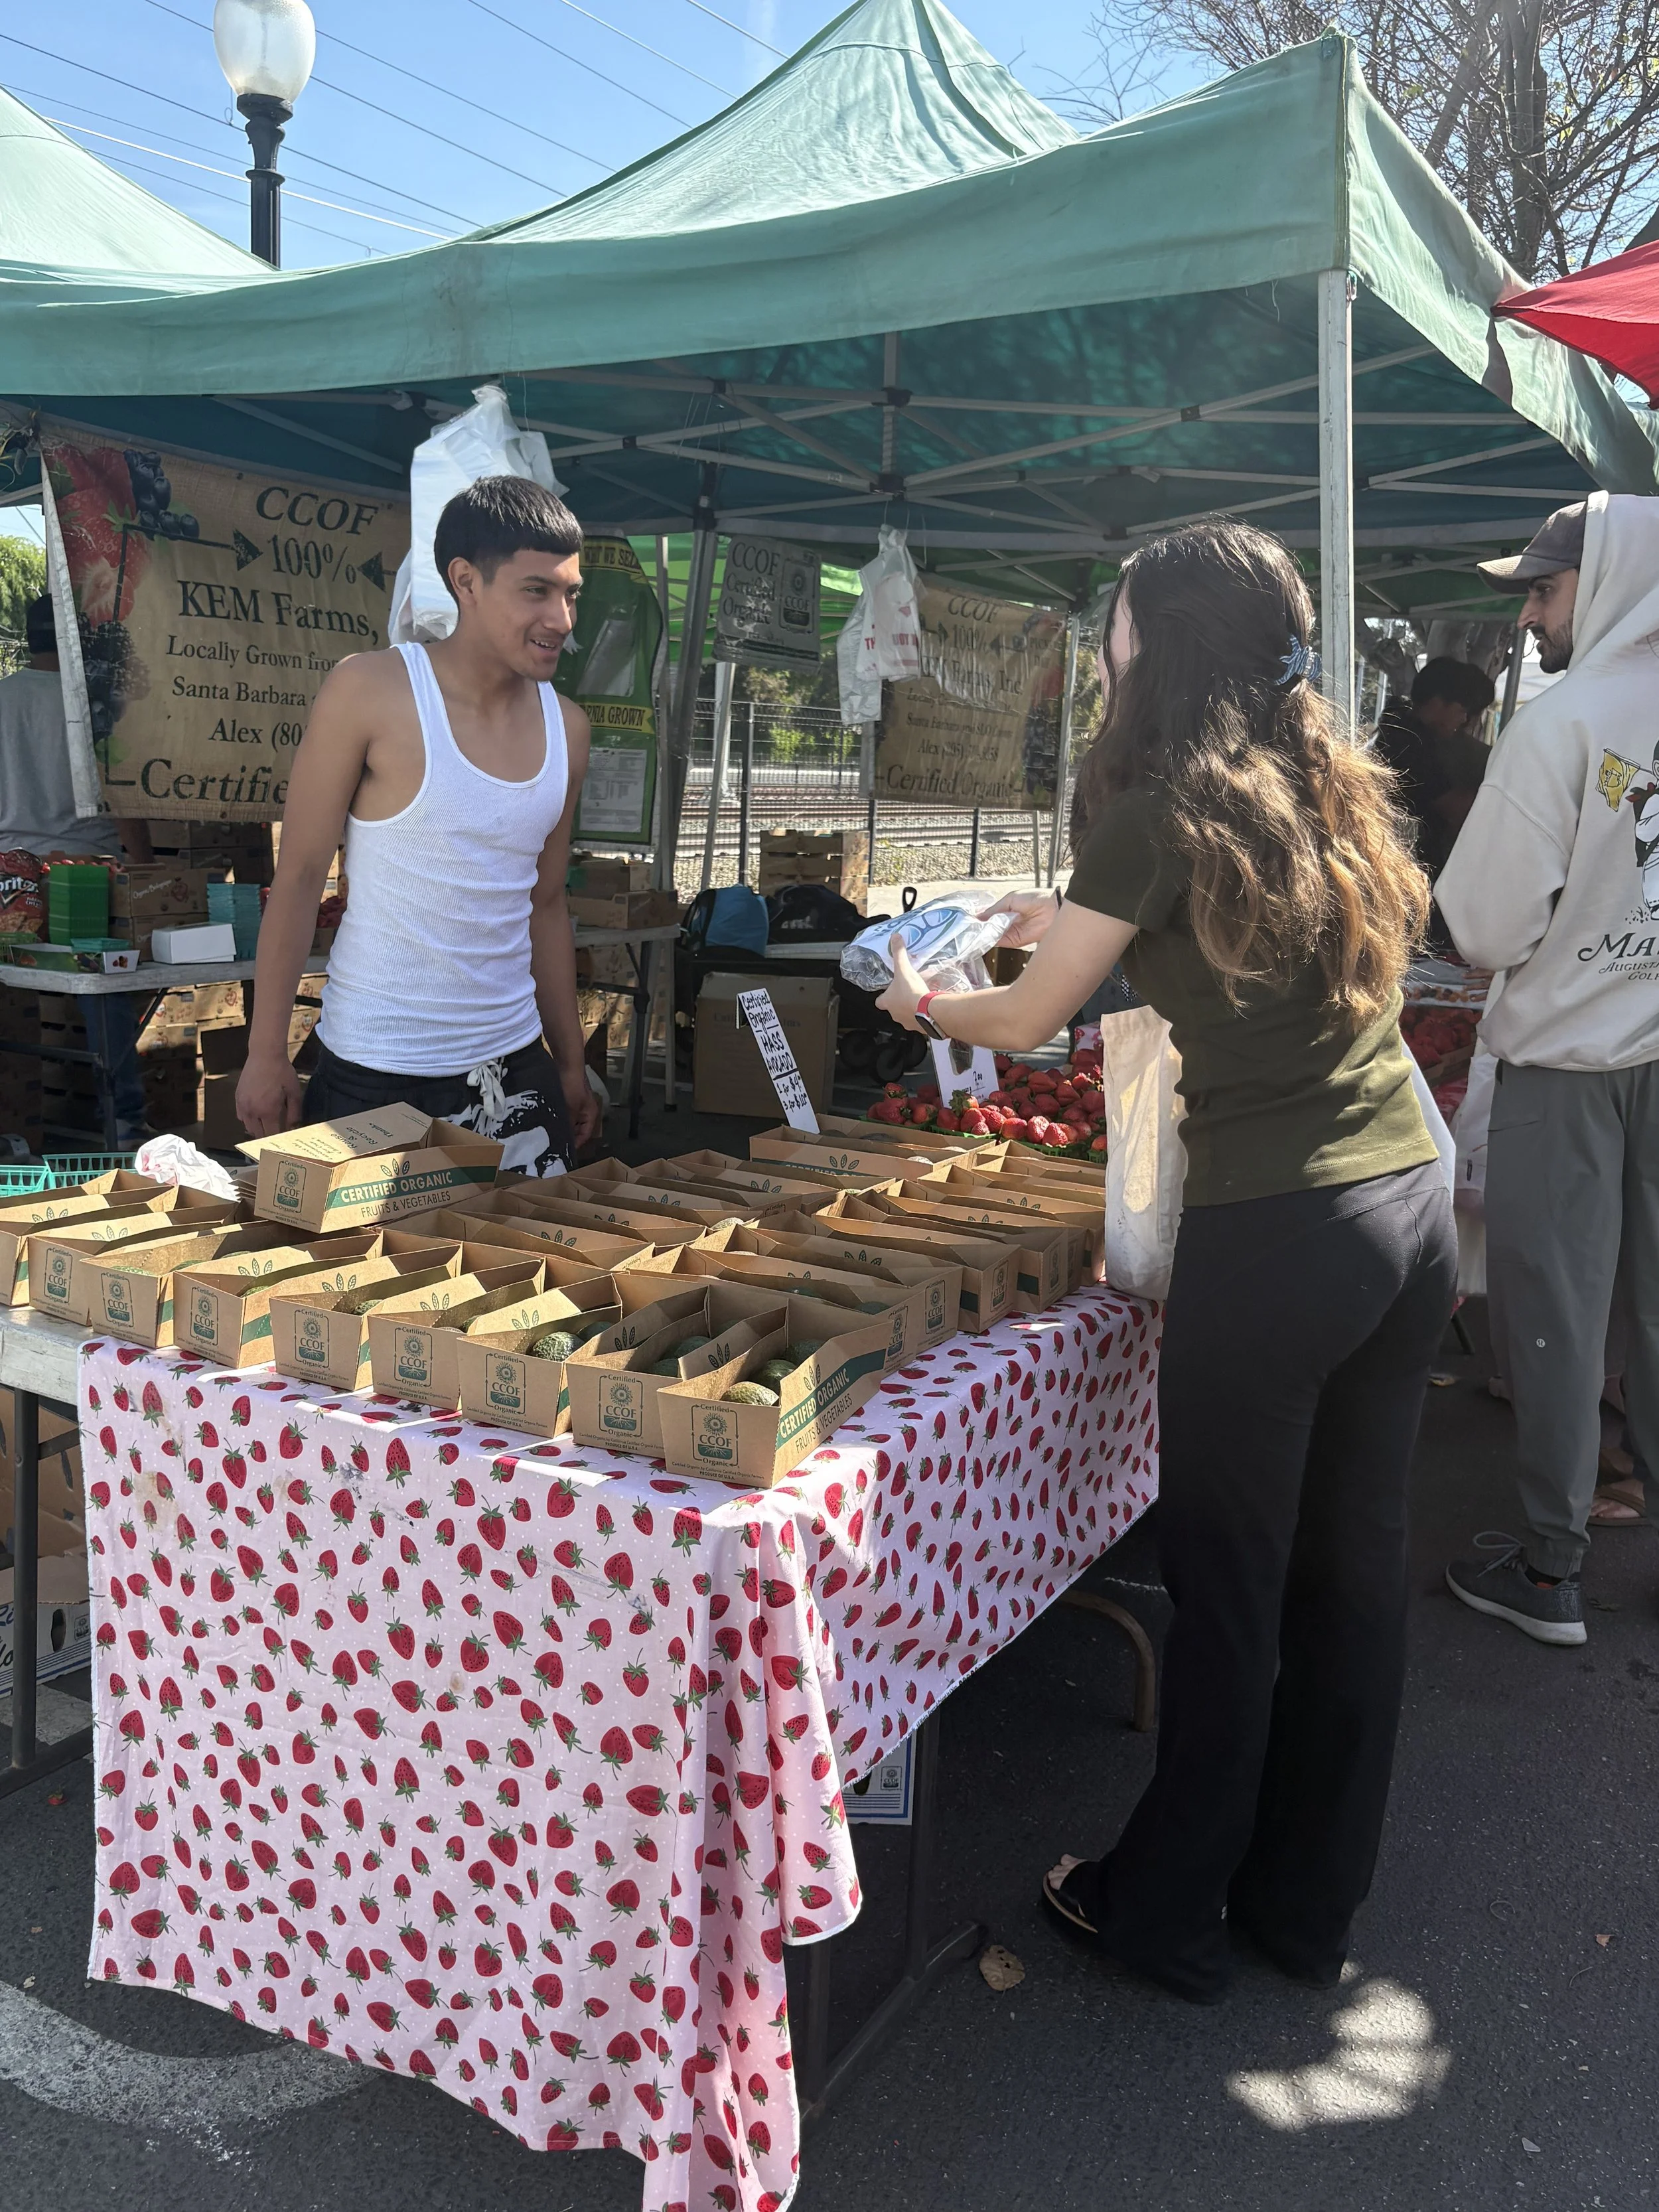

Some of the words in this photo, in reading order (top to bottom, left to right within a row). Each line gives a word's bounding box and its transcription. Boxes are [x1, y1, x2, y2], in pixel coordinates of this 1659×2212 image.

[256, 486, 379, 535] CCOF
[267, 534, 357, 584] 100%
[732, 542, 780, 575] CCOF
[785, 595, 810, 611] CCOF
[948, 597, 997, 624] CCOF
[177, 580, 264, 624] KEM
[271, 592, 379, 645] Farms,
[166, 635, 240, 668] Locally
[246, 644, 303, 670] Grown
[307, 652, 340, 672] fro
[999, 670, 1023, 695] Inc.
[172, 676, 229, 701] Santa
[236, 682, 306, 707] Barbara
[608, 705, 646, 727] GROWN
[208, 717, 263, 744] Alex
[271, 721, 308, 753] (80
[917, 738, 939, 755] Alex
[887, 764, 958, 794] Certified
[1577, 932, 1659, 962] MA
[748, 1007, 776, 1033] Organic
[761, 1031, 785, 1055] HASS
[764, 1052, 794, 1074] AVOCADO
[783, 1100, 788, 1110] 3
[330, 1134, 358, 1149] Reuse
[346, 1126, 378, 1145] Recycle
[279, 1185, 301, 1197] CCOF
[340, 1181, 397, 1203] CERTIFIED
[400, 1171, 453, 1193] ORGANIC
[361, 1203, 391, 1217] FRUITS
[393, 1201, 399, 1211] &
[399, 1191, 451, 1210] VEGETABLES
[48, 1274, 67, 1287] CCOF
[108, 1299, 128, 1311] CCOF
[928, 1305, 943, 1318] CCOF
[194, 1314, 215, 1328] CCOF
[301, 1309, 323, 1318] Certified
[401, 1327, 426, 1336] Certified
[300, 1337, 325, 1351] CCOF
[302, 1359, 323, 1368] Organic
[400, 1356, 427, 1368] CCOF
[494, 1353, 519, 1363] Certified
[401, 1378, 423, 1387] Organic
[608, 1374, 636, 1383] Certified
[492, 1382, 520, 1396] CCOF
[494, 1404, 517, 1415] Organic
[700, 1404, 730, 1413] Certified
[780, 1397, 817, 1438] CERTIFIED
[817, 1368, 849, 1406] ORGANIC
[605, 1405, 636, 1418] CCOF
[795, 1427, 816, 1453] FRUITS
[816, 1422, 822, 1435] &
[820, 1393, 853, 1430] VEGETABLES
[608, 1428, 632, 1438] Organic
[699, 1434, 732, 1447] CCOF
[702, 1457, 729, 1467] Organic
